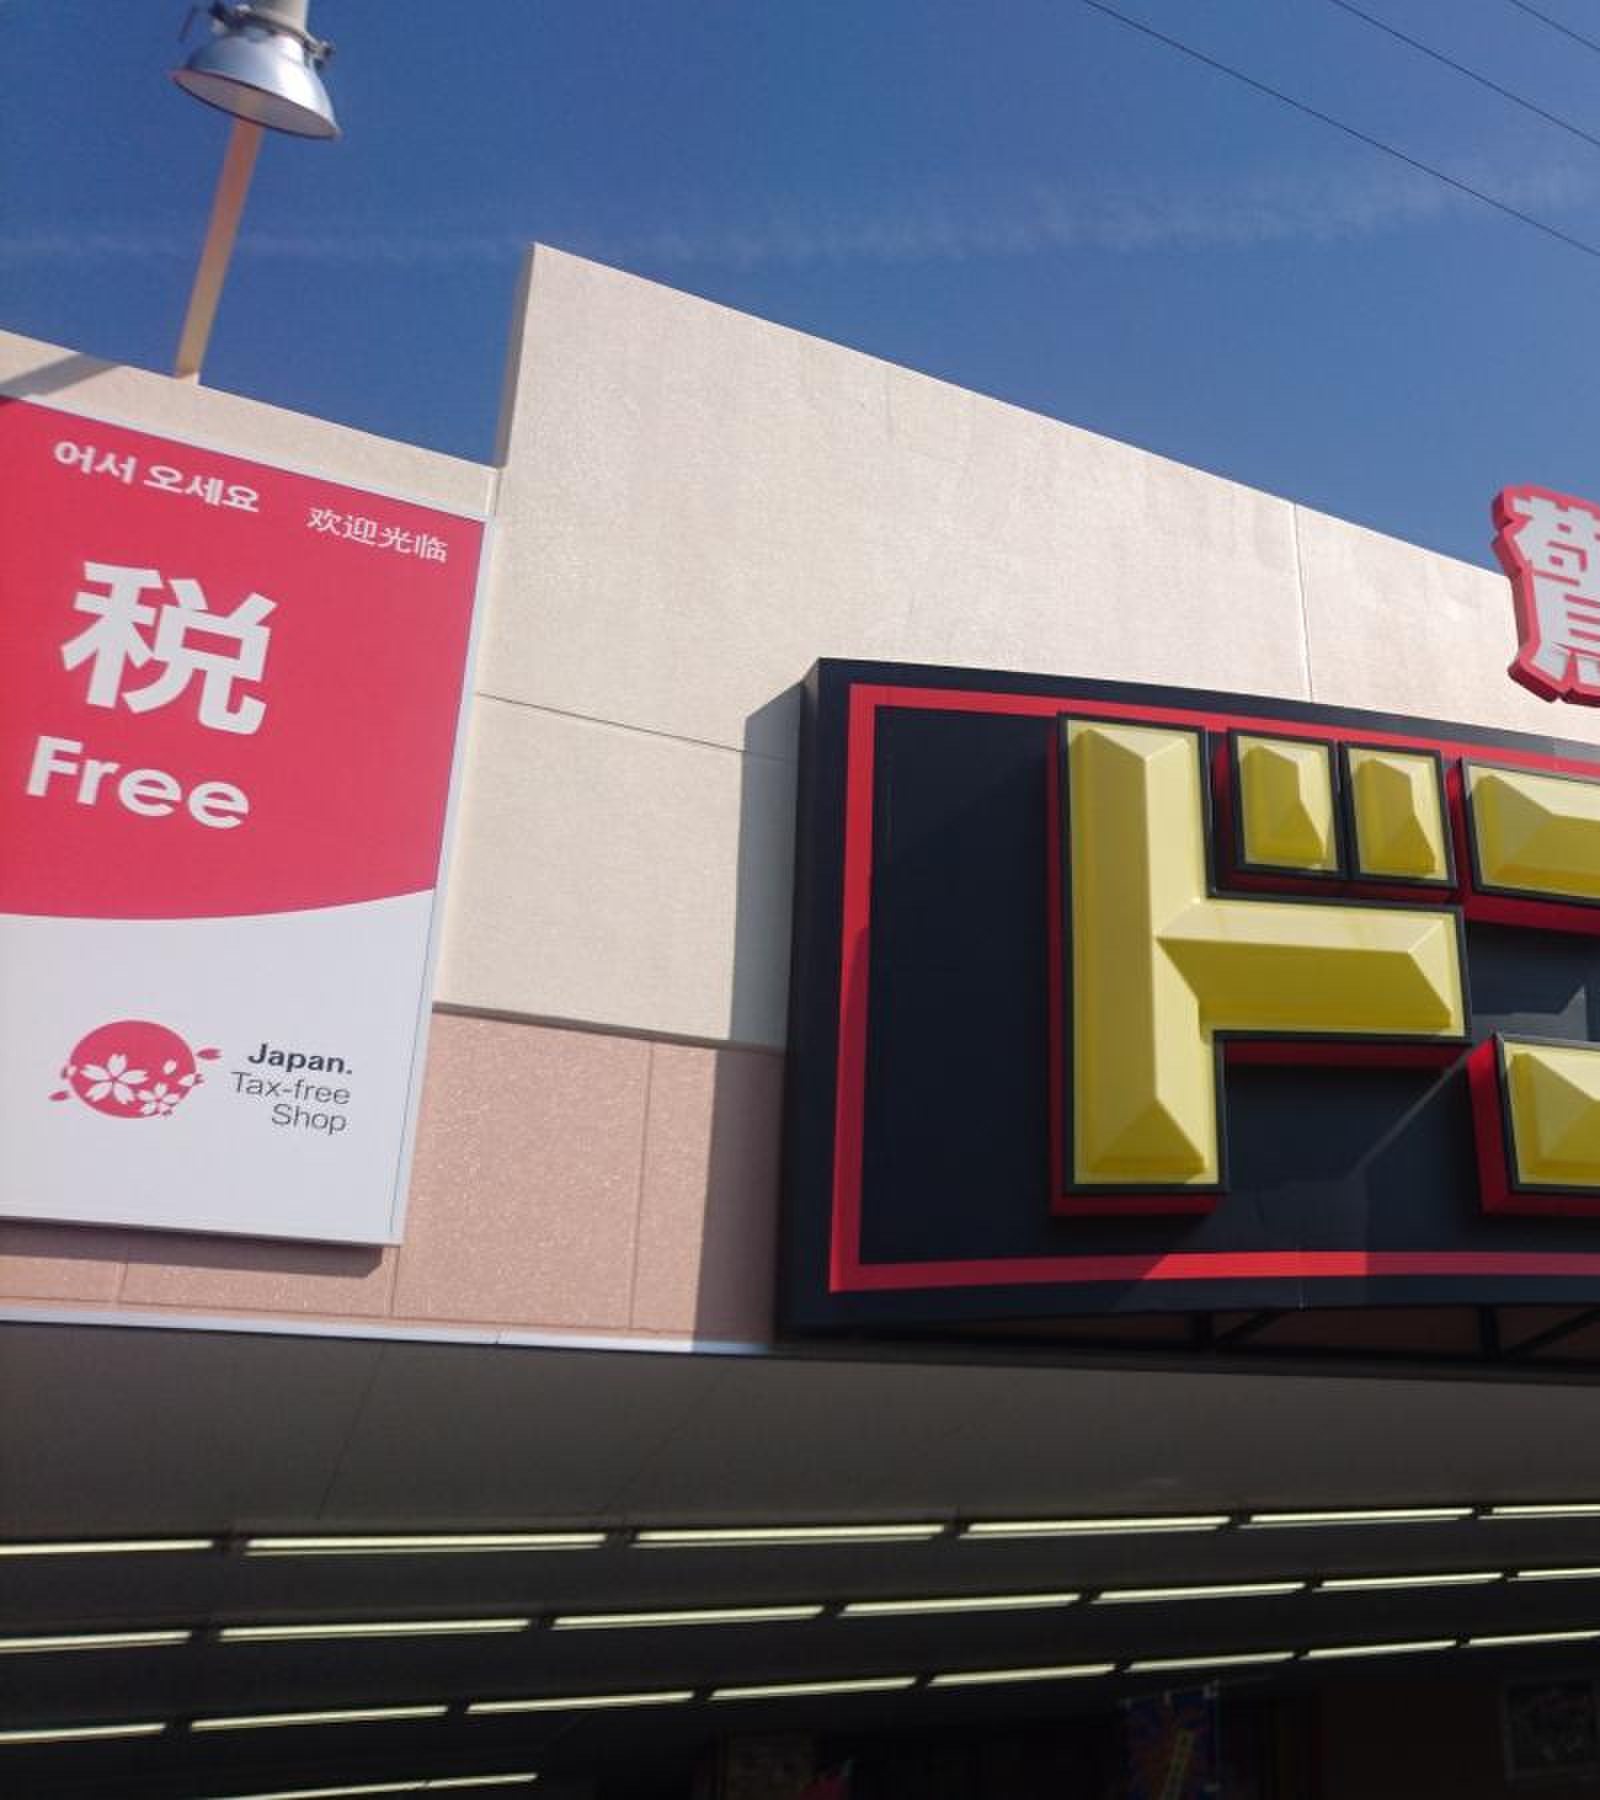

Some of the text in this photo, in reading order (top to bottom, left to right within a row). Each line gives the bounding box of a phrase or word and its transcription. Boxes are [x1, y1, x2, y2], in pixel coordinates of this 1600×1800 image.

[53, 440, 260, 513] 어서 오세요
[305, 507, 449, 564] 欢迎光临
[60, 561, 278, 735] 税
[26, 735, 250, 829] Free
[247, 1042, 353, 1075] Japan.
[230, 1070, 351, 1105] Tax-free
[271, 1102, 348, 1136] Shop
